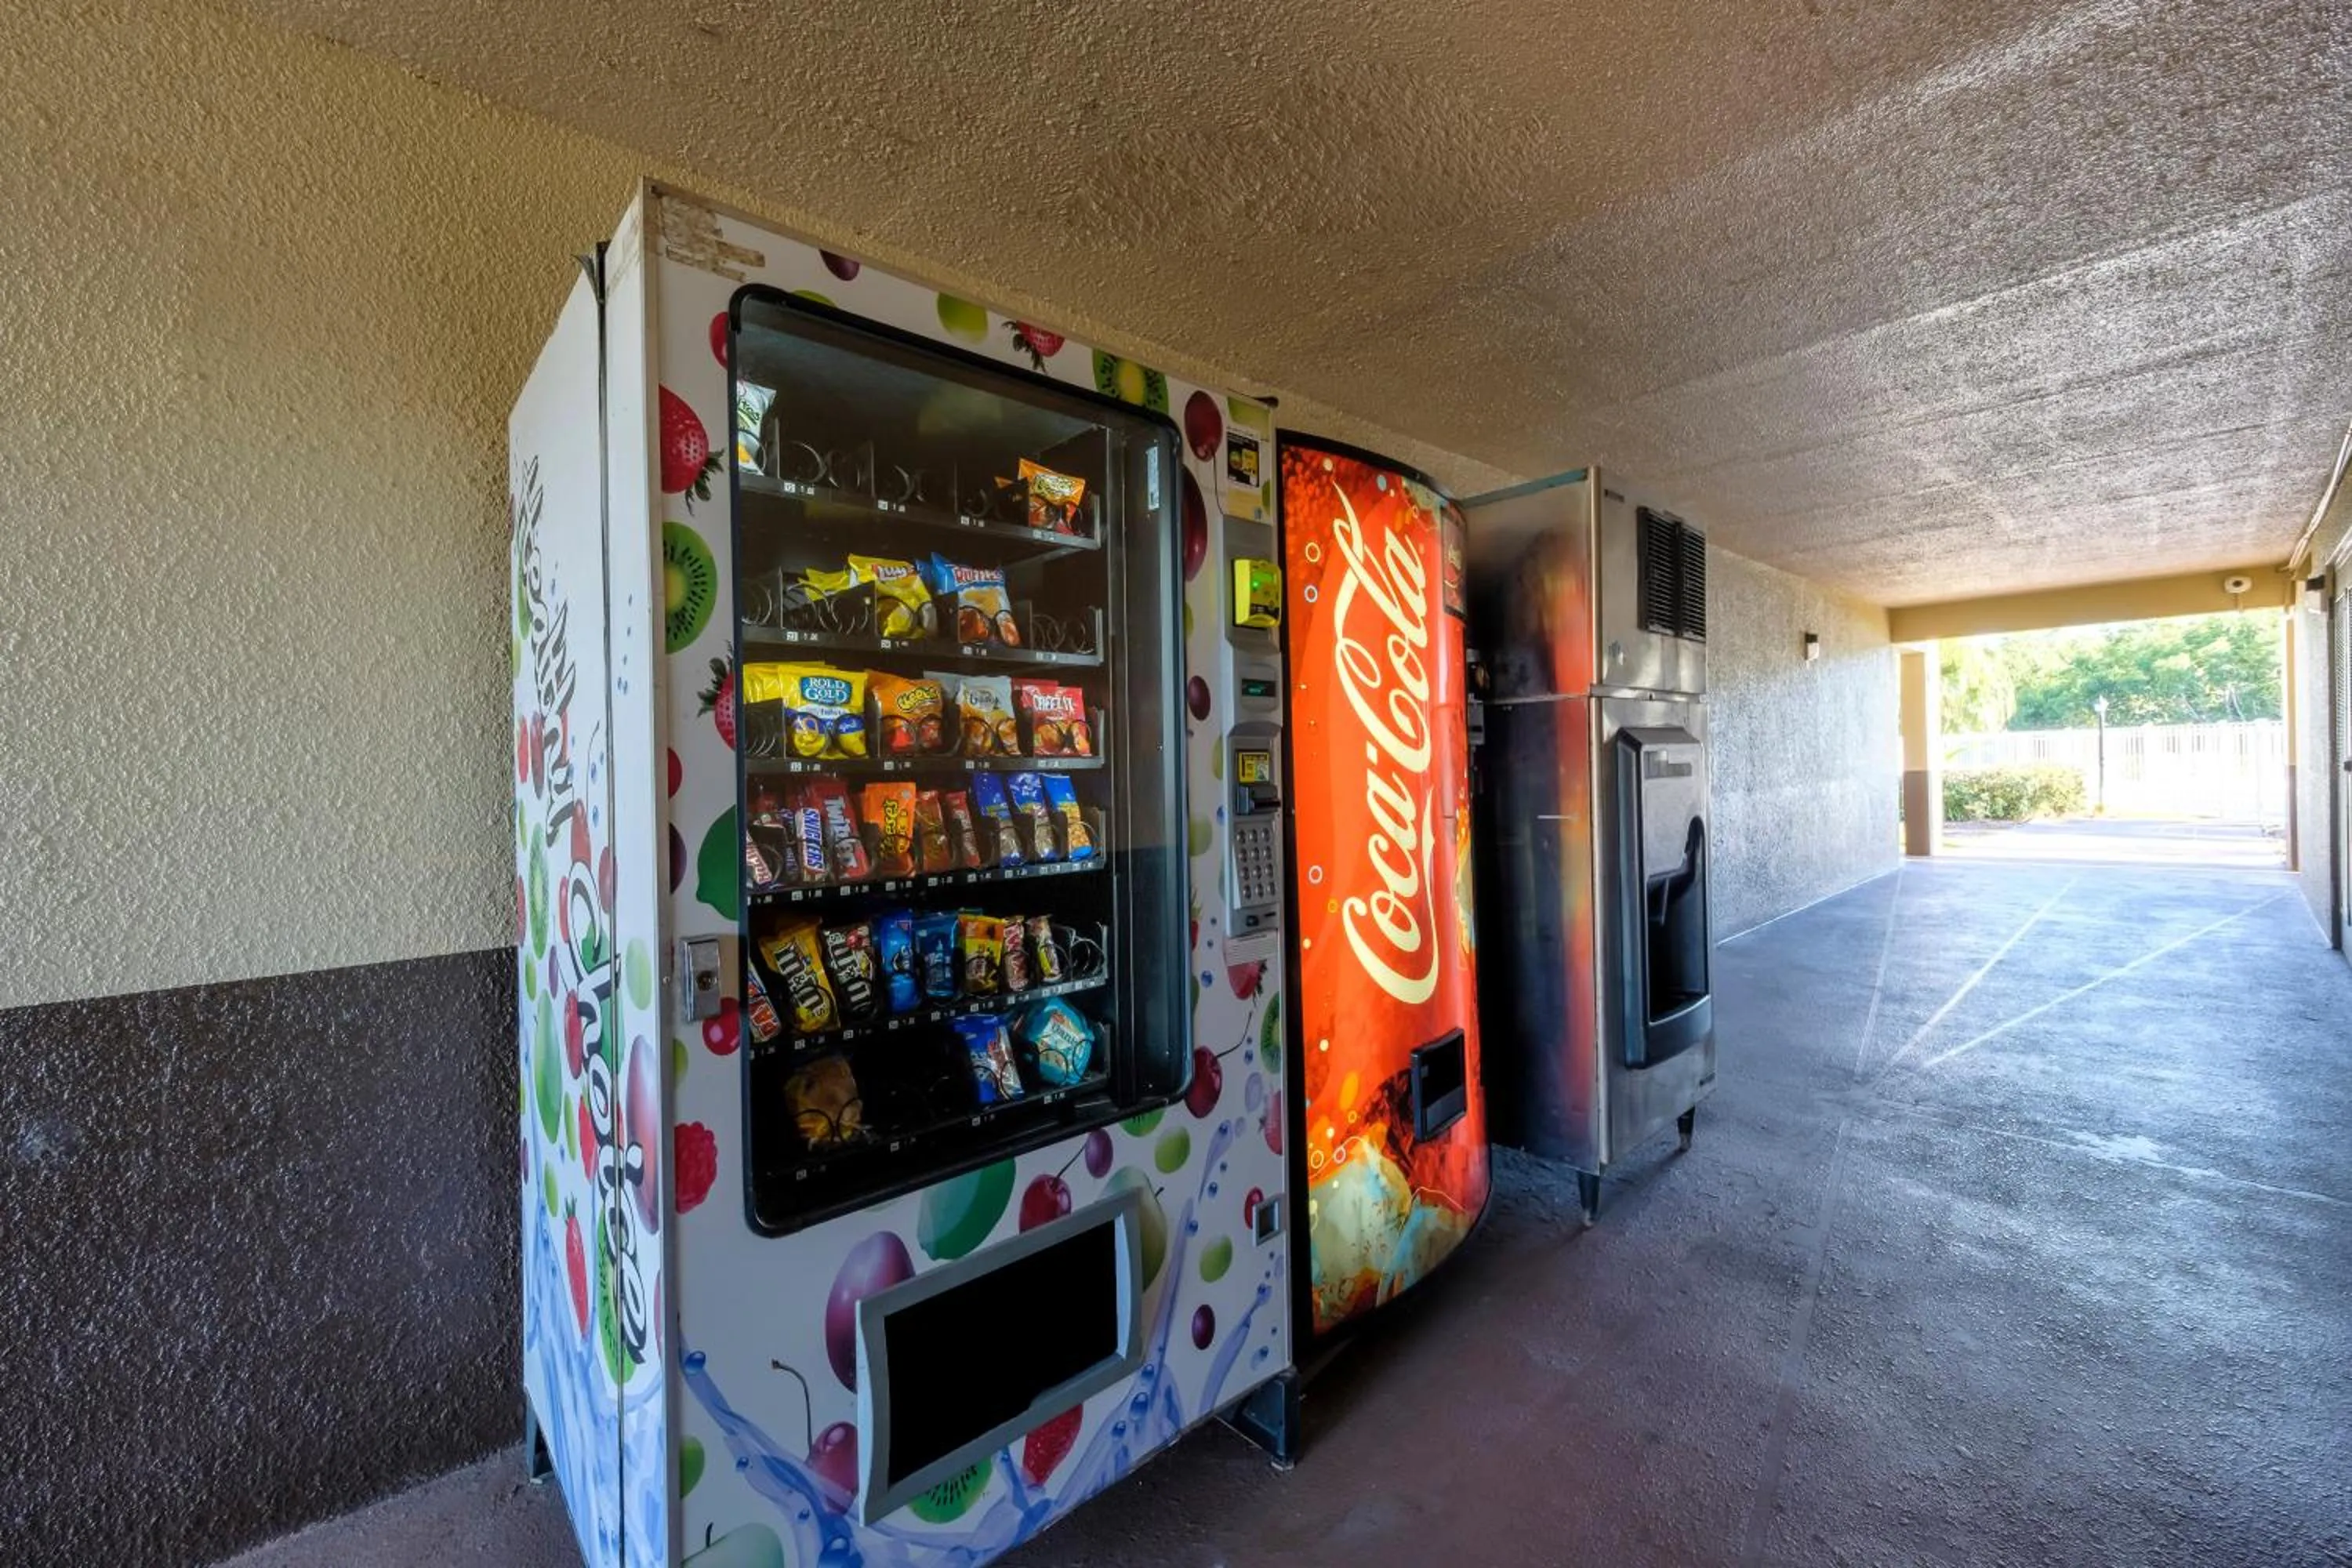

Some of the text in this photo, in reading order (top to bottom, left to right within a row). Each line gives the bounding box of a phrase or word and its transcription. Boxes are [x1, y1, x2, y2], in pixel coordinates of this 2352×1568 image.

[517, 455, 575, 849] Healthy
[805, 688, 848, 702] GOLD
[809, 677, 845, 689] ROLD
[1332, 480, 1439, 1005] Coca-Cola
[573, 861, 649, 1366] Choice
